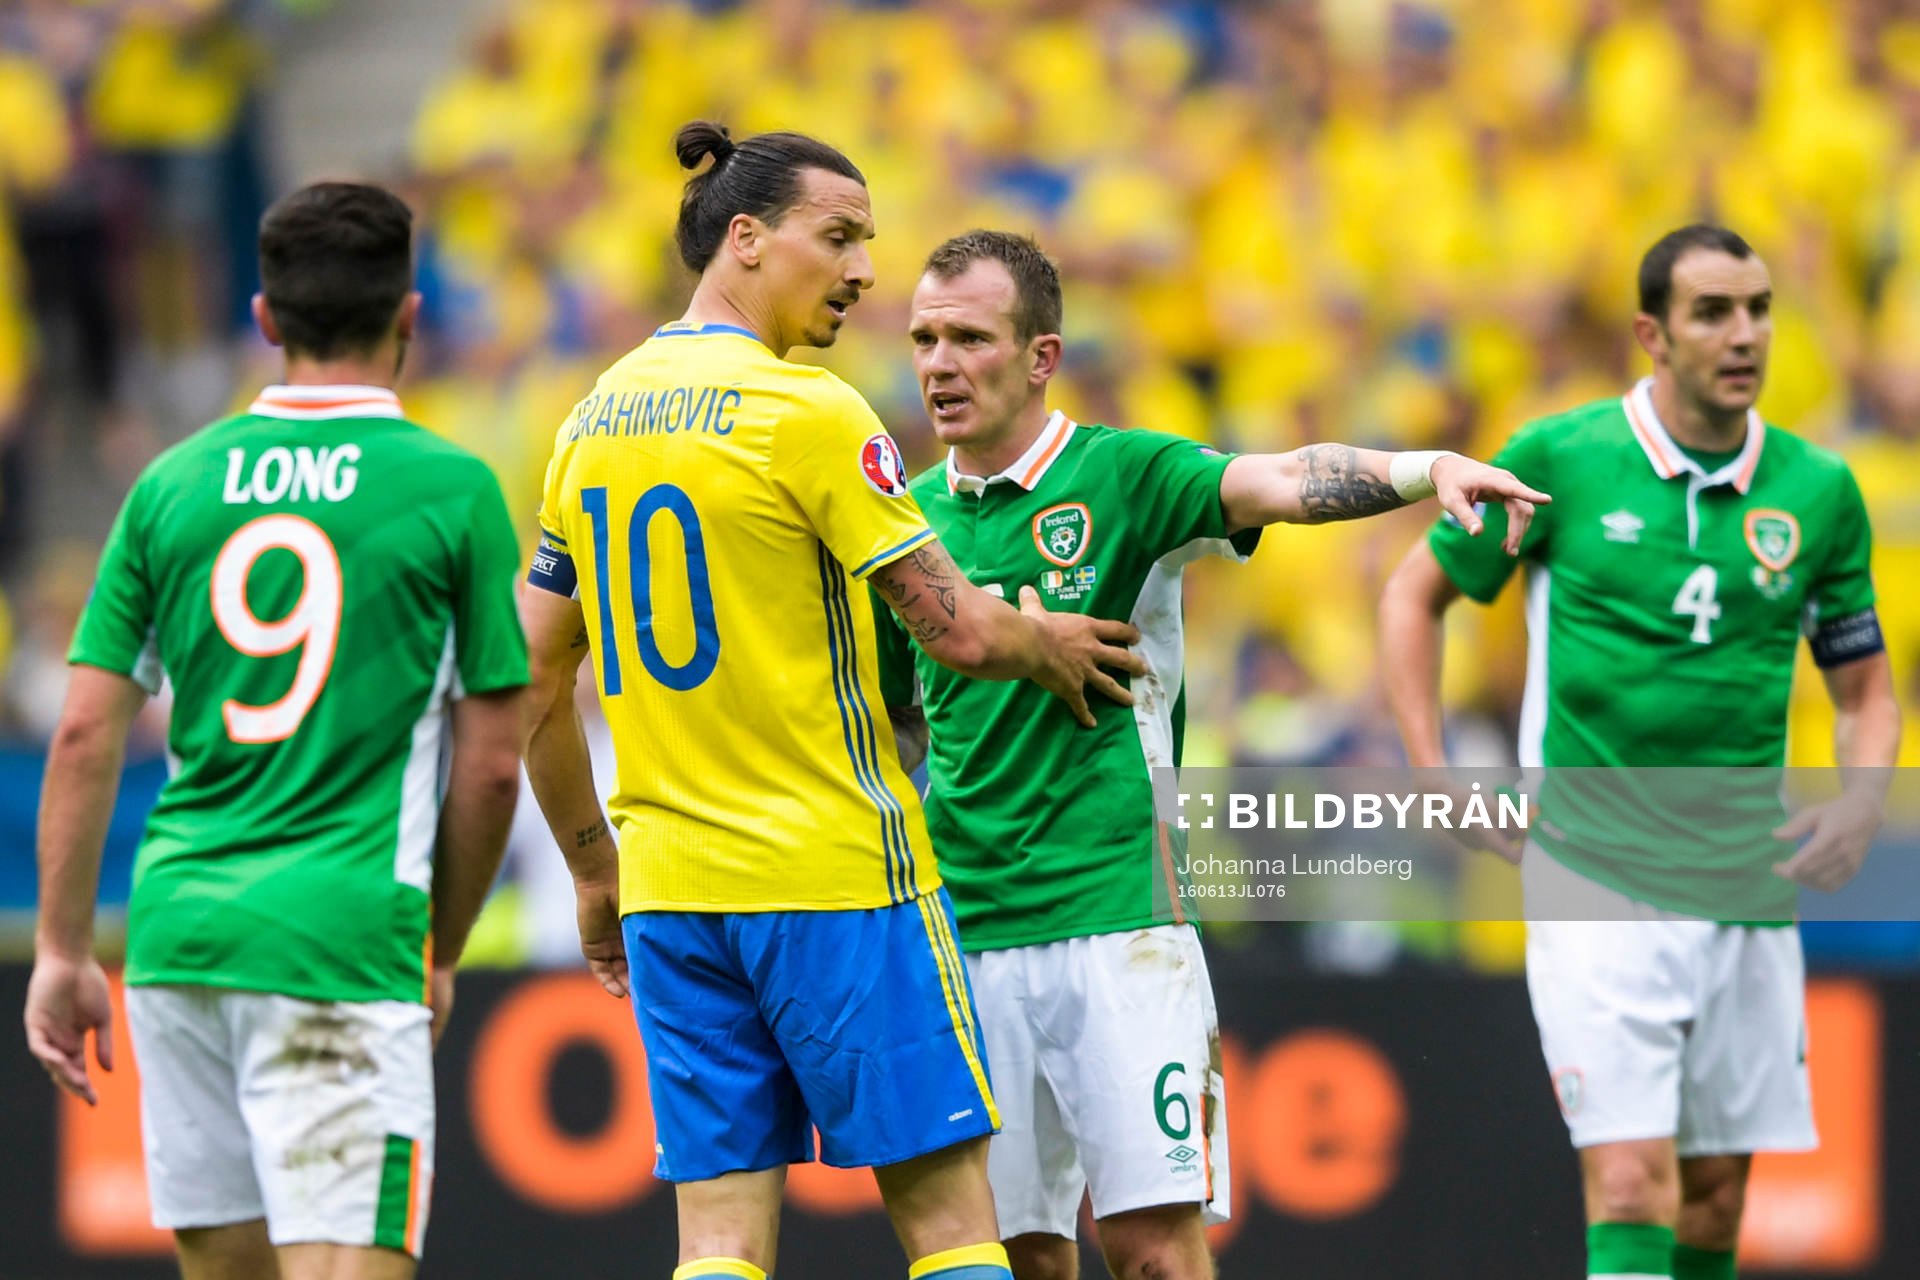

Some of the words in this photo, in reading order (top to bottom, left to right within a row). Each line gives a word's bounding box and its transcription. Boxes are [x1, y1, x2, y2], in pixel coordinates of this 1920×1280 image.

[222, 443, 362, 504] LONG
[1045, 512, 1078, 527] Ireland
[210, 512, 344, 744] 9
[581, 483, 721, 696] 10
[1671, 563, 1721, 644] 4
[1154, 1062, 1191, 1140] 6
[1170, 1163, 1197, 1174] umbro
